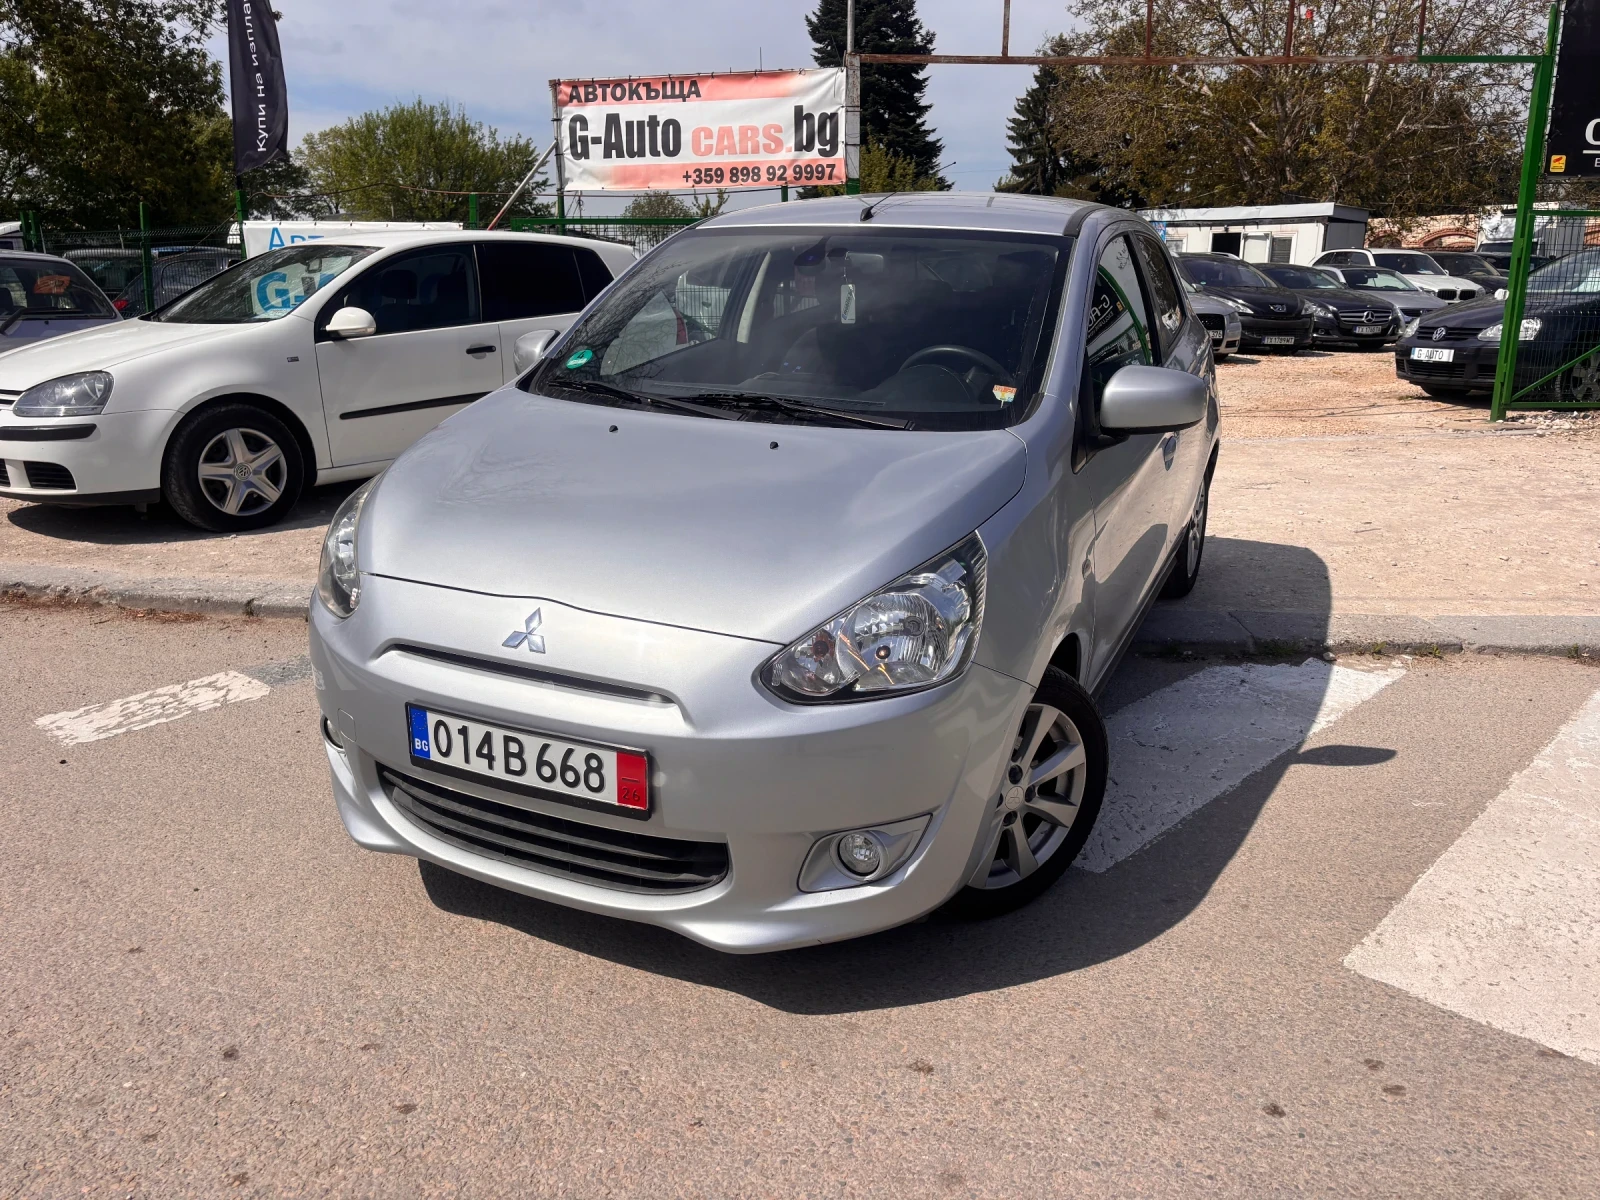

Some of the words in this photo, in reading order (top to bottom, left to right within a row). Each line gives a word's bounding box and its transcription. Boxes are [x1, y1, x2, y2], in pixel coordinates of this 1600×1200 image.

[243, 0, 259, 67] изпла
[255, 73, 266, 97] на
[569, 79, 702, 103] АВТОКЪЩА
[256, 104, 269, 152] Купи
[569, 112, 682, 161] G-Auto
[682, 166, 725, 185] +359
[729, 165, 761, 183] 898
[766, 164, 788, 182] 92
[793, 163, 836, 182] 9997
[415, 738, 429, 751] BG
[434, 719, 605, 793] 014B668
[622, 787, 640, 802] 26
